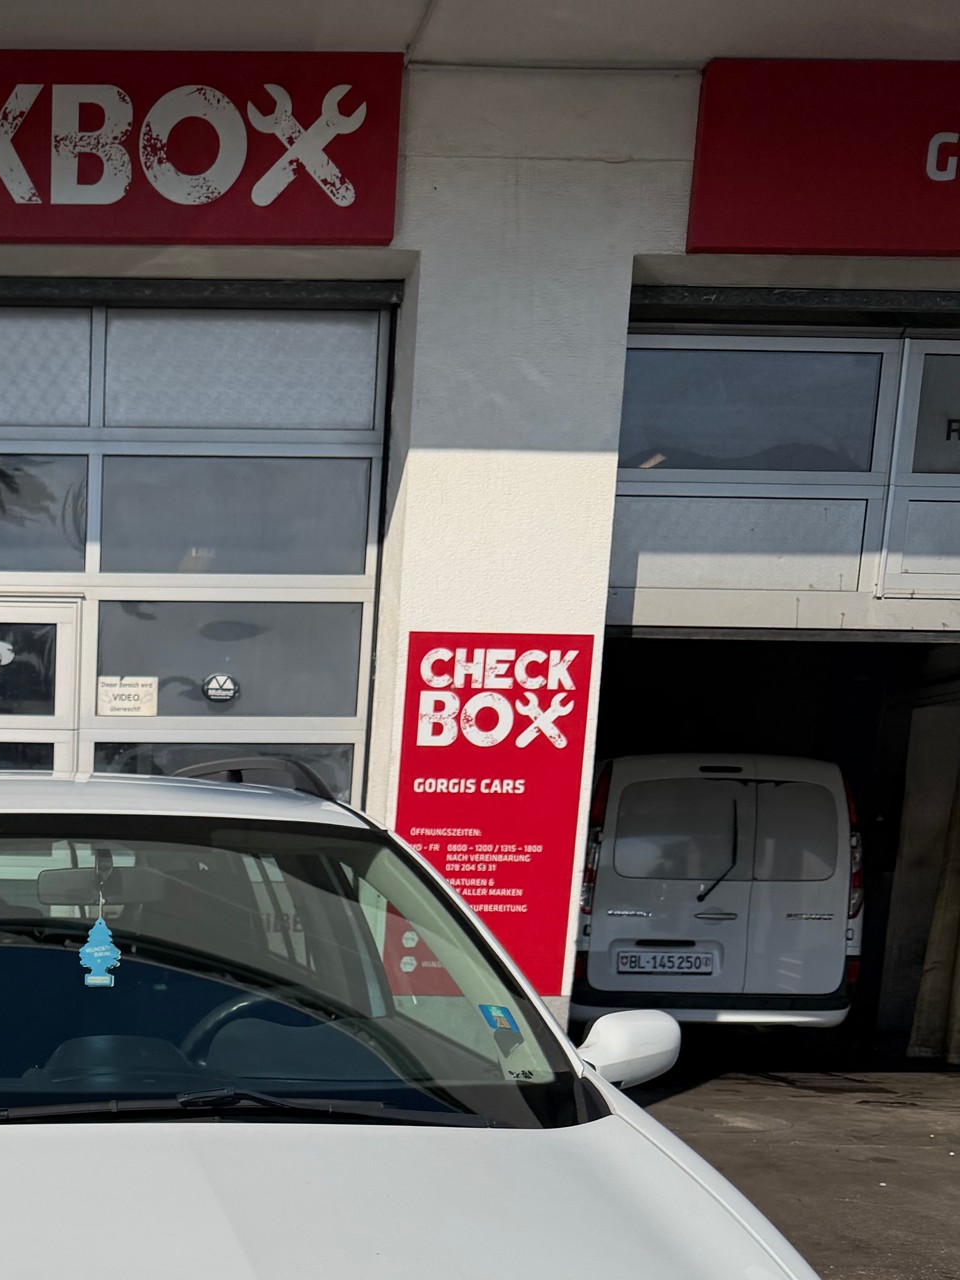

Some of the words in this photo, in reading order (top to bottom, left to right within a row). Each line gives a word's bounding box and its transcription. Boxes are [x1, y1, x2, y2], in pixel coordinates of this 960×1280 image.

[420, 647, 580, 690] CHECK
[112, 693, 140, 702] VIDEO
[416, 690, 575, 749] BOX
[413, 777, 476, 794] GORGIS
[480, 778, 525, 795] CARS
[428, 843, 440, 852] FR
[447, 844, 468, 853] 0800
[475, 844, 493, 853] 1200
[524, 845, 543, 853] 1800
[446, 854, 469, 862] NACH
[469, 854, 531, 863] VEREINBARUNG
[461, 864, 476, 872] 204
[462, 889, 489, 897] ALLER
[489, 889, 523, 897] MARKEN
